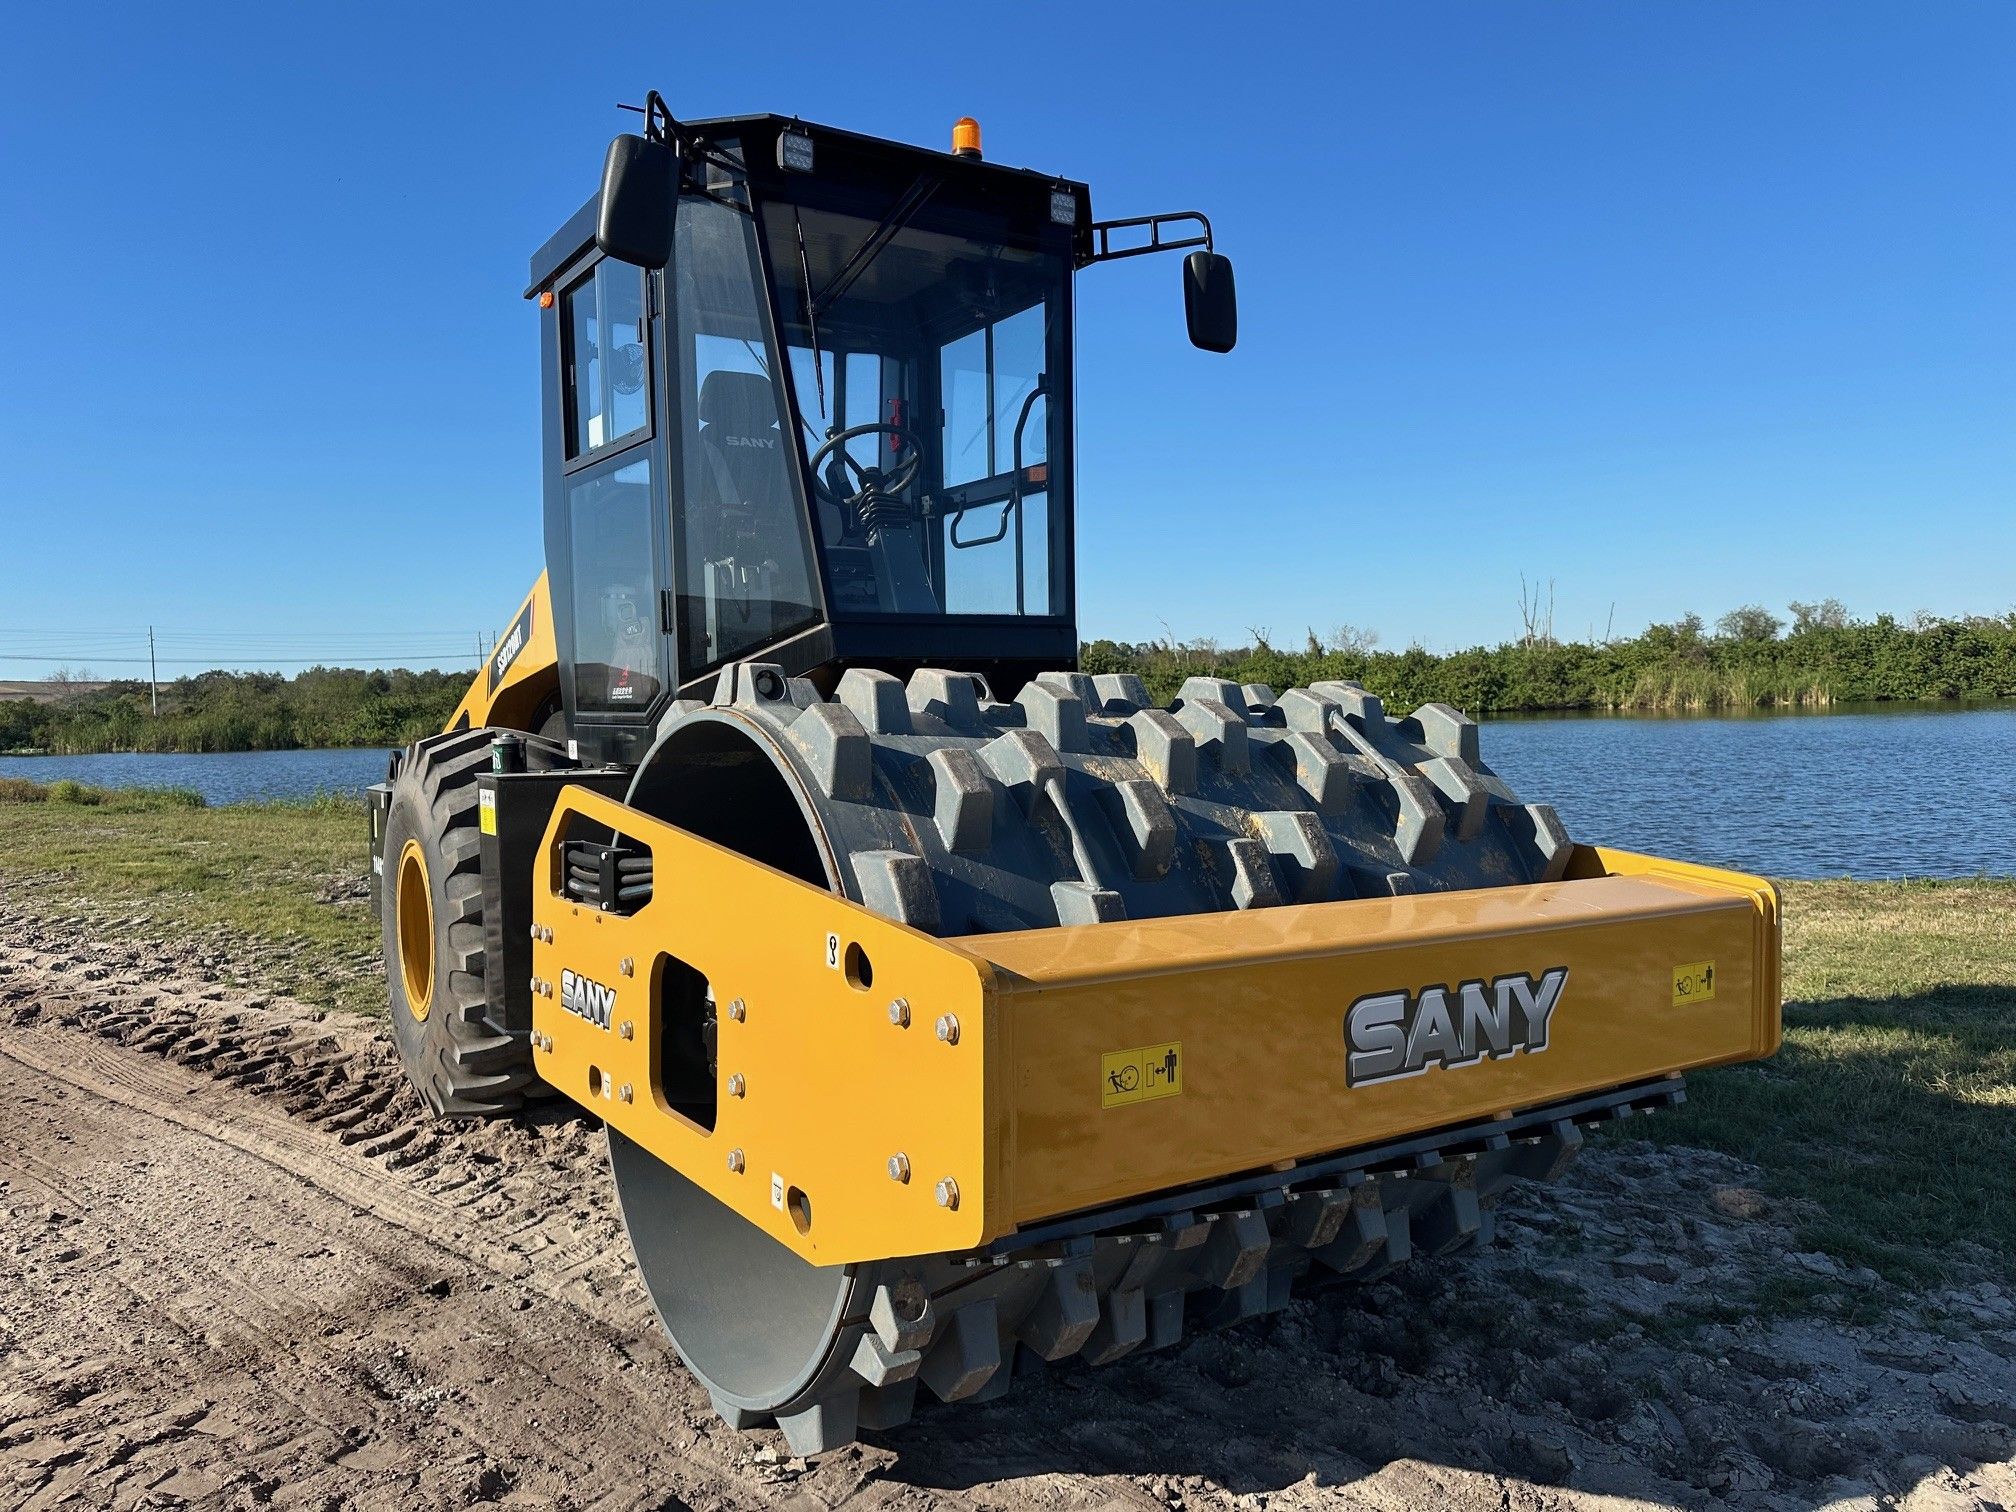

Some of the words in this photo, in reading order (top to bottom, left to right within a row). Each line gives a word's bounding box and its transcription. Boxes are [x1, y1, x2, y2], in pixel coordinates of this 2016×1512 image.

[726, 435, 774, 449] SANY
[561, 967, 616, 1032] SANY
[1343, 966, 1567, 1089] SANY
